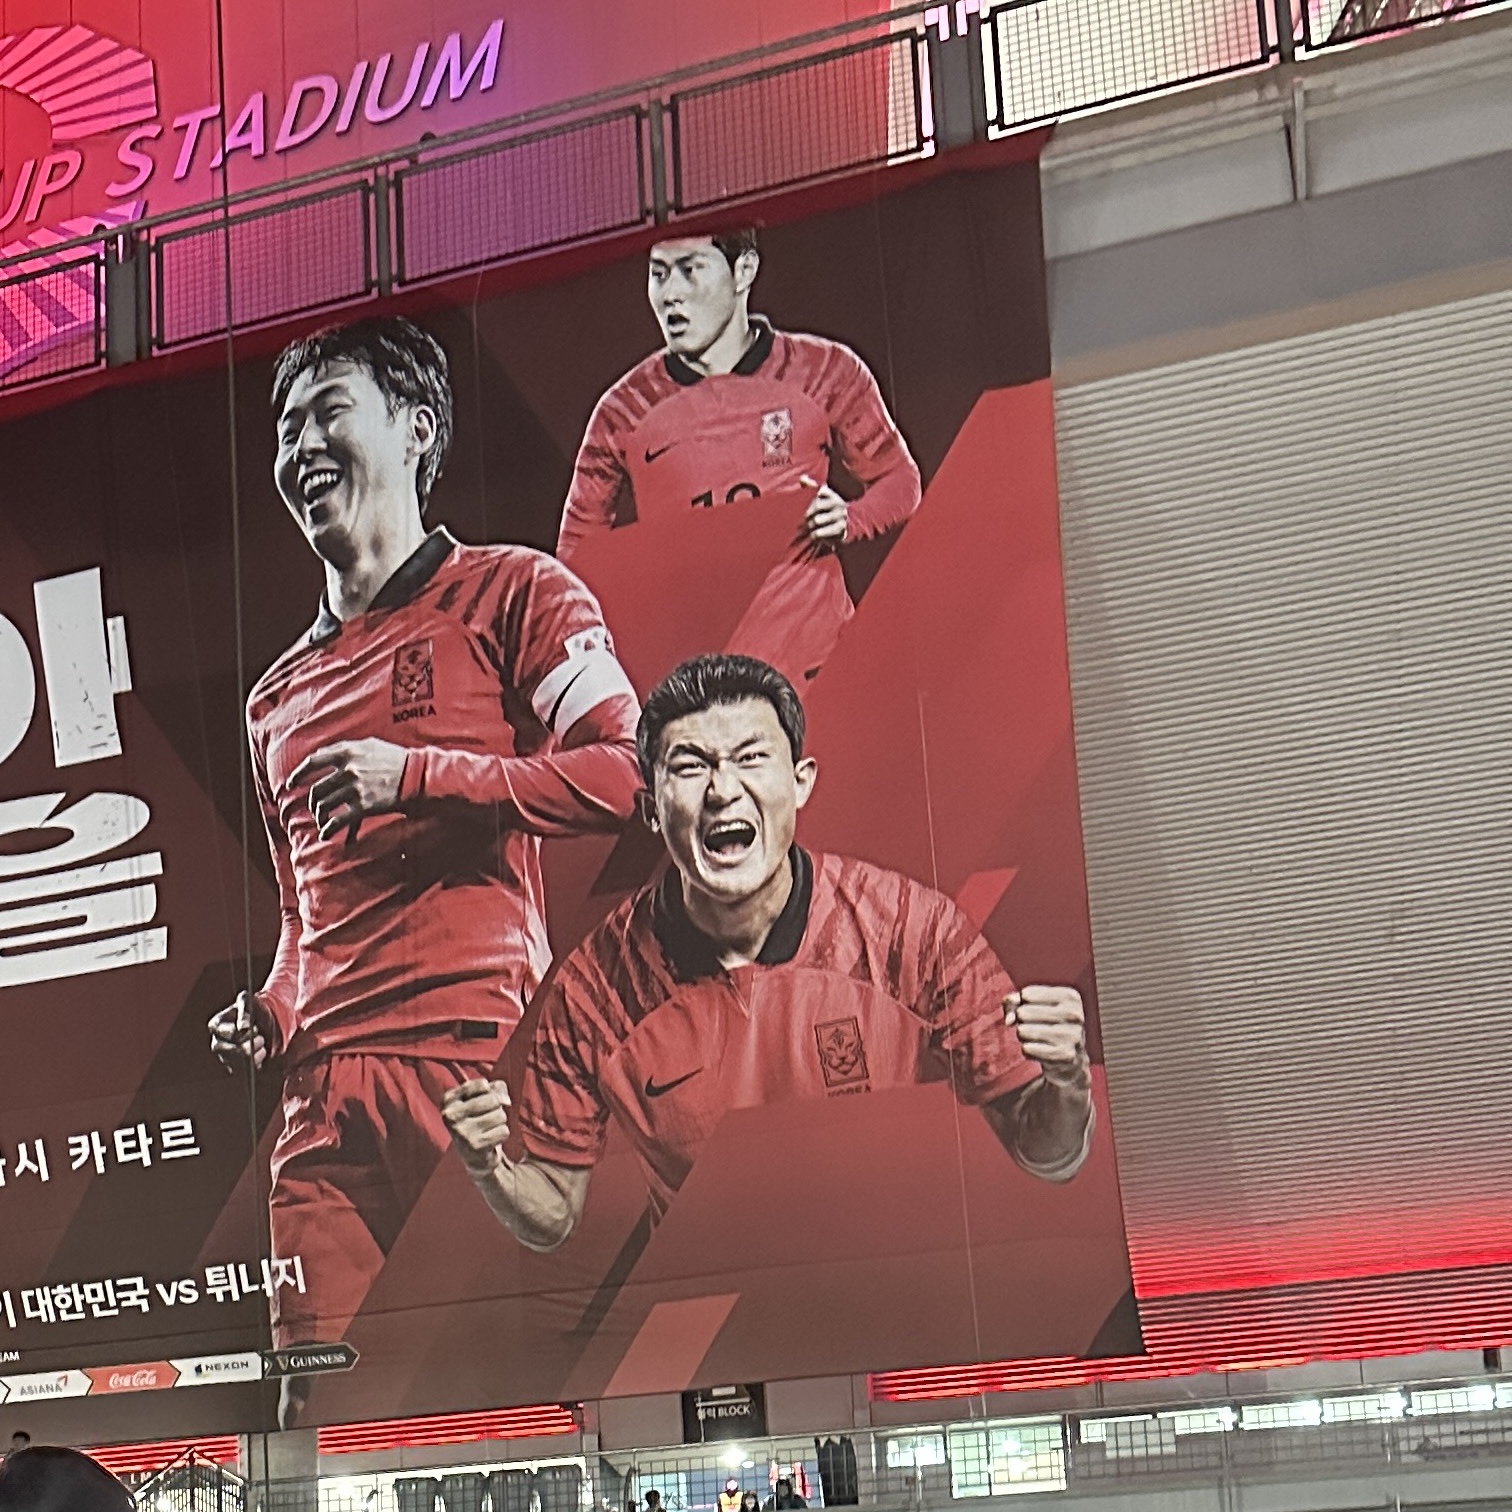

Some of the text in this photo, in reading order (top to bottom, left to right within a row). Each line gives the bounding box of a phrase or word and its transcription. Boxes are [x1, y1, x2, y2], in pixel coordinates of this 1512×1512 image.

[104, 19, 506, 197] STADIUM
[67, 1117, 201, 1176] 카타르
[21, 1276, 150, 1324] 대한민국
[205, 1256, 308, 1302] 튀니지
[20, 1383, 63, 1396] ASIANA
